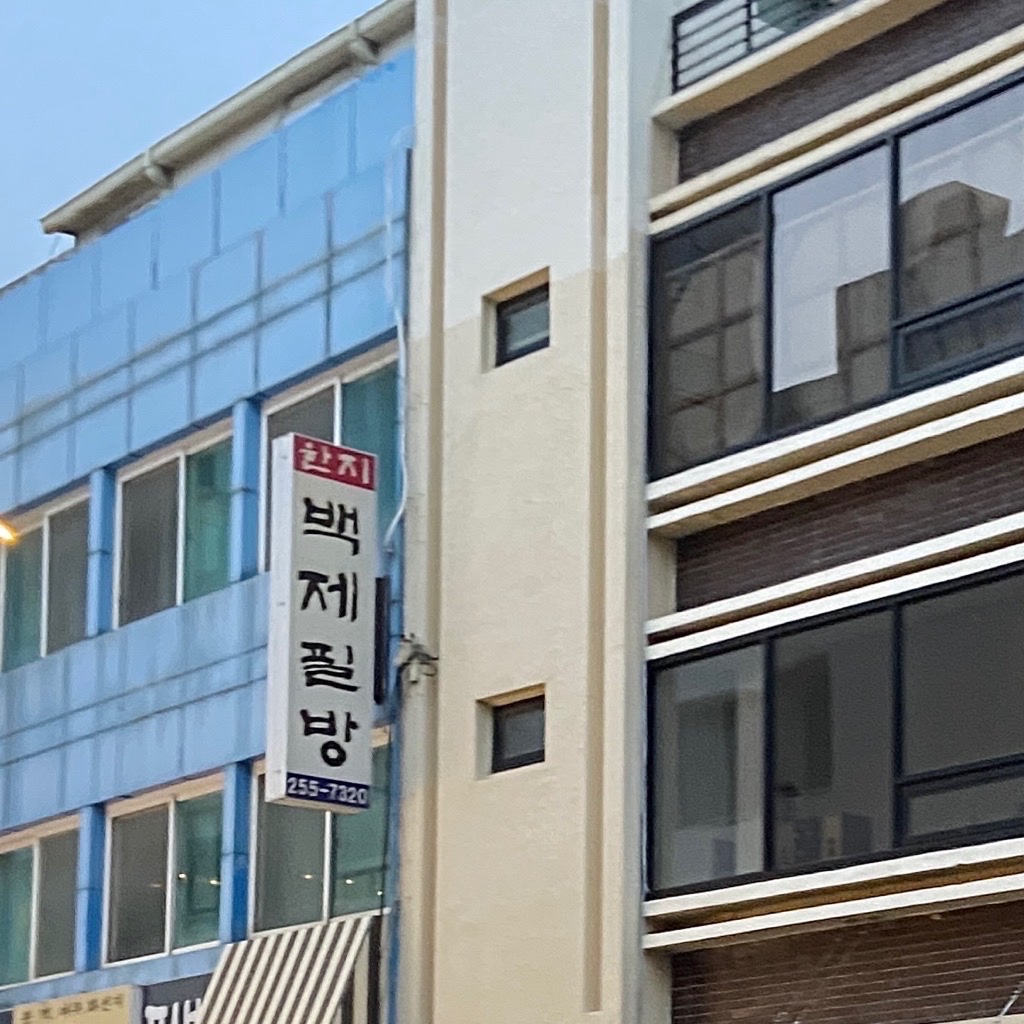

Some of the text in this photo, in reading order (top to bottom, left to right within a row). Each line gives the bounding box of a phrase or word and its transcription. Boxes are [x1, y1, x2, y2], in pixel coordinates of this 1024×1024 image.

[297, 441, 371, 484] 한지
[298, 497, 361, 767] 백제필방
[287, 776, 368, 805] 255-7320
